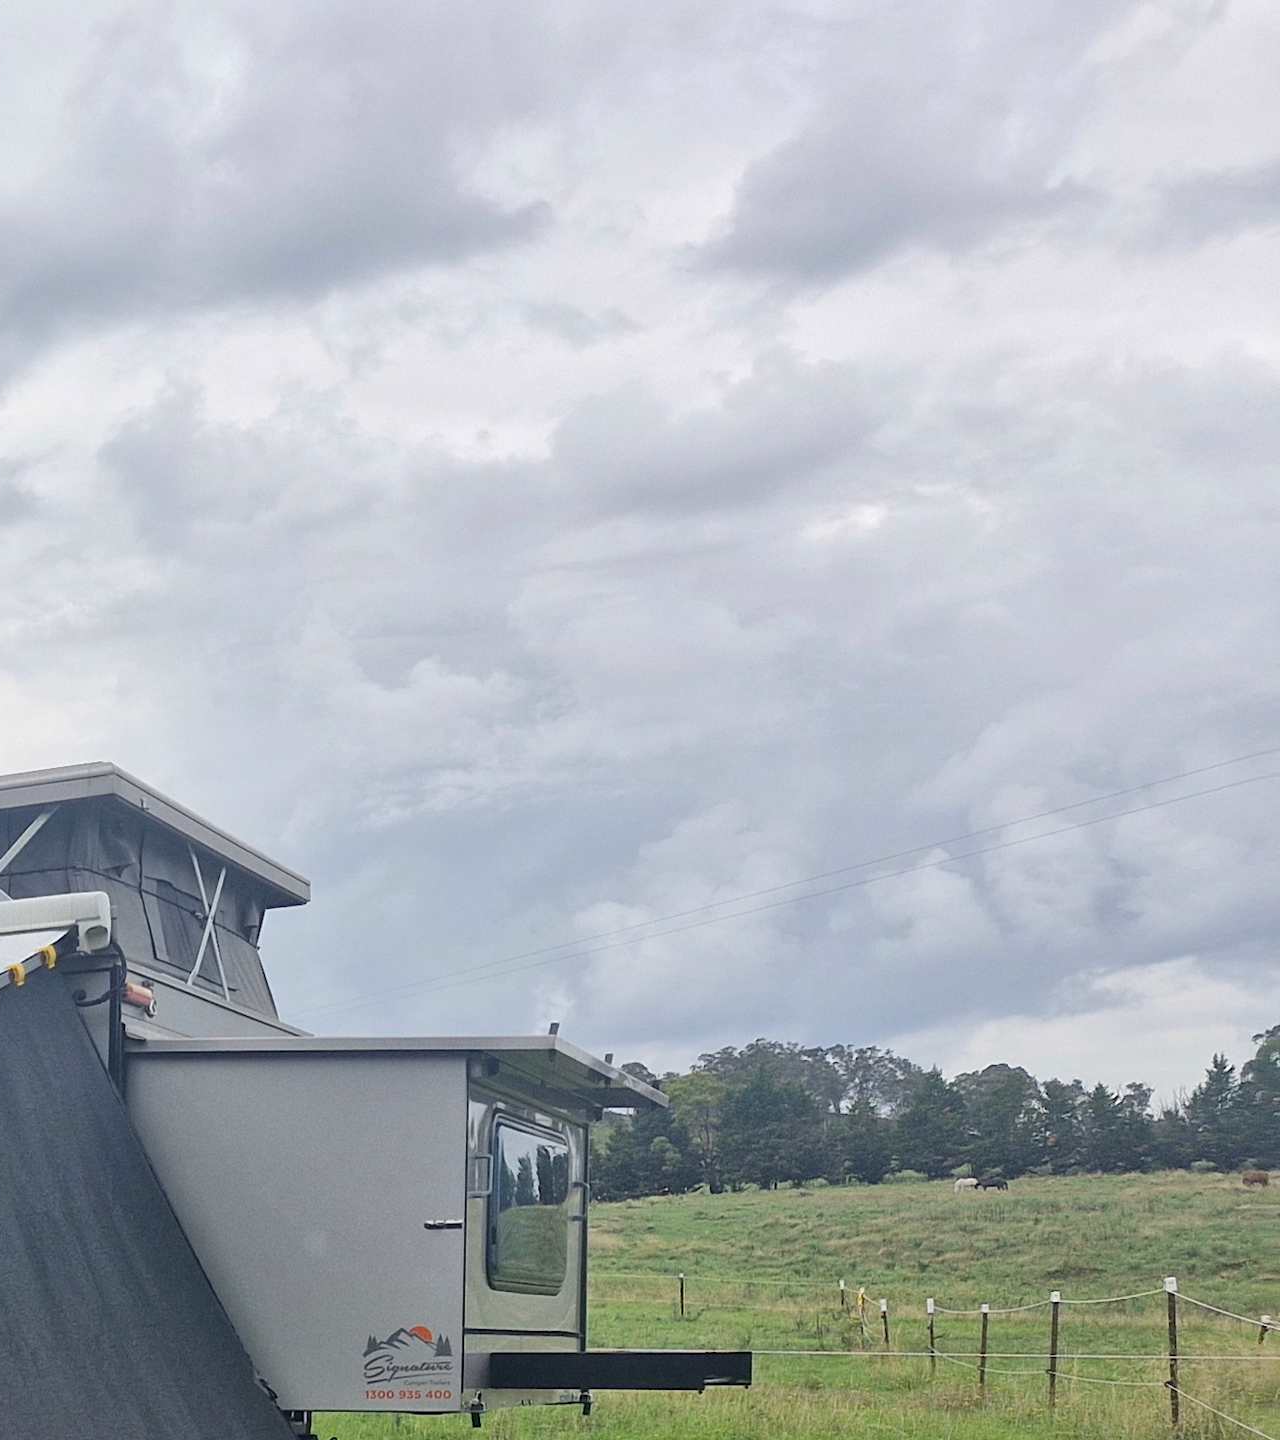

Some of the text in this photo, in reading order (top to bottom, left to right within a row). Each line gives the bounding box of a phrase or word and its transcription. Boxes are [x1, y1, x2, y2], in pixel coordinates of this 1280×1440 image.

[363, 1354, 454, 1383] Signature
[365, 1389, 452, 1400] 1300 935 400
